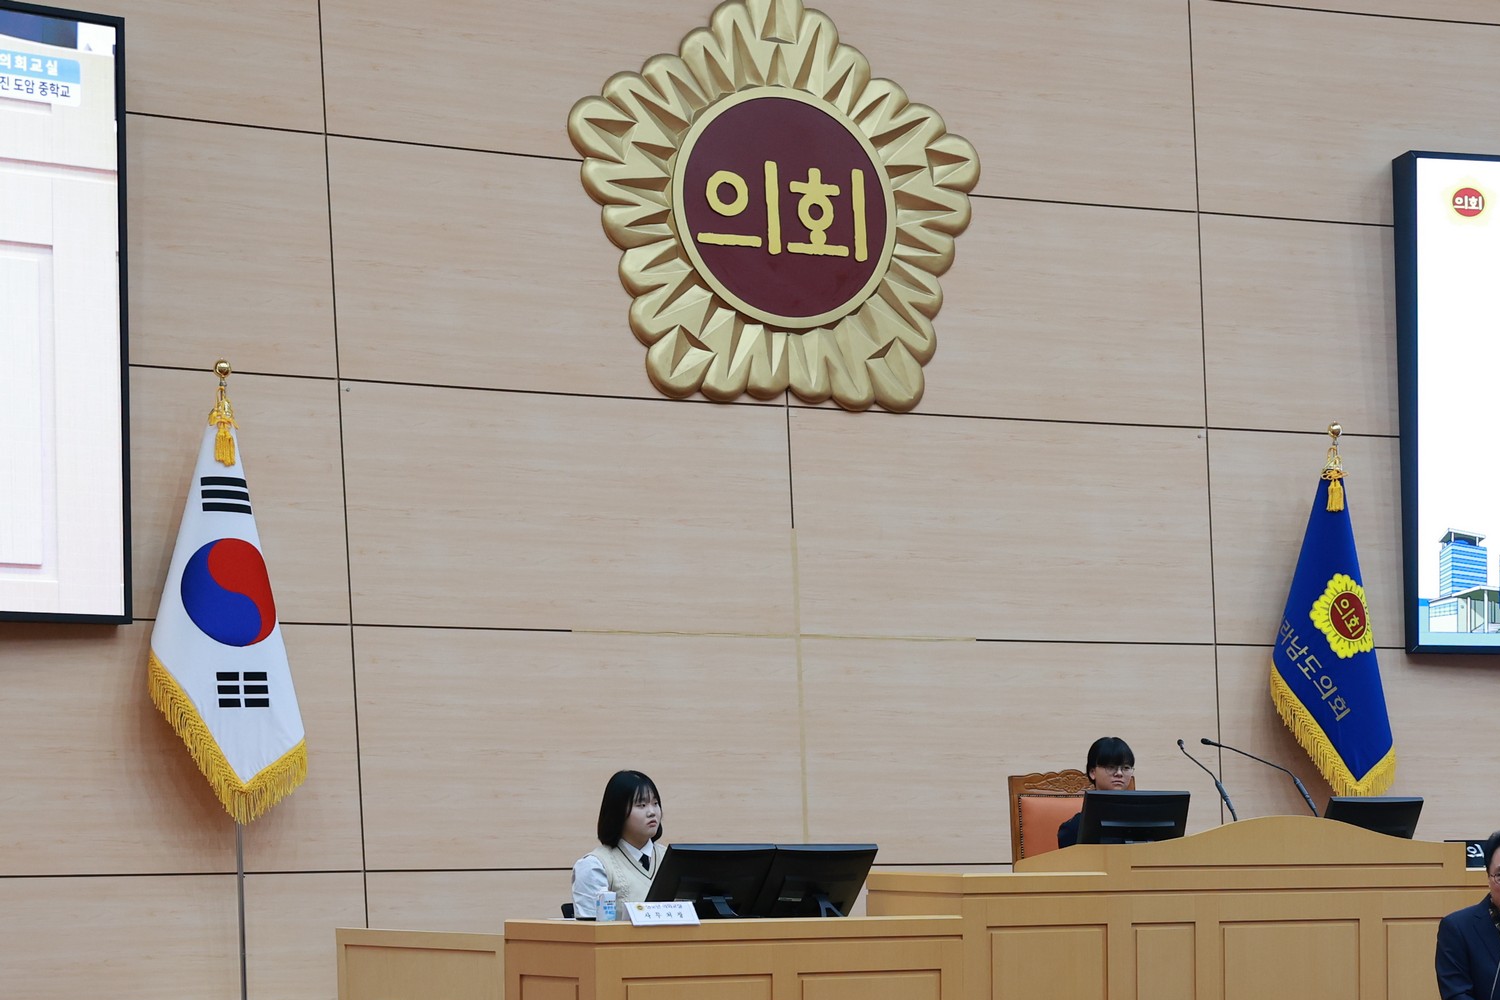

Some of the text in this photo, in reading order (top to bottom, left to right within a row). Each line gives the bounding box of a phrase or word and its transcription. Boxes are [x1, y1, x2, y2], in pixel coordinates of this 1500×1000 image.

[0, 53, 58, 76] 의회교실
[14, 78, 35, 94] 도암
[39, 81, 71, 98] 중학교
[697, 160, 868, 262] 의회
[1453, 195, 1483, 210] 의회
[1333, 598, 1364, 637] 의회
